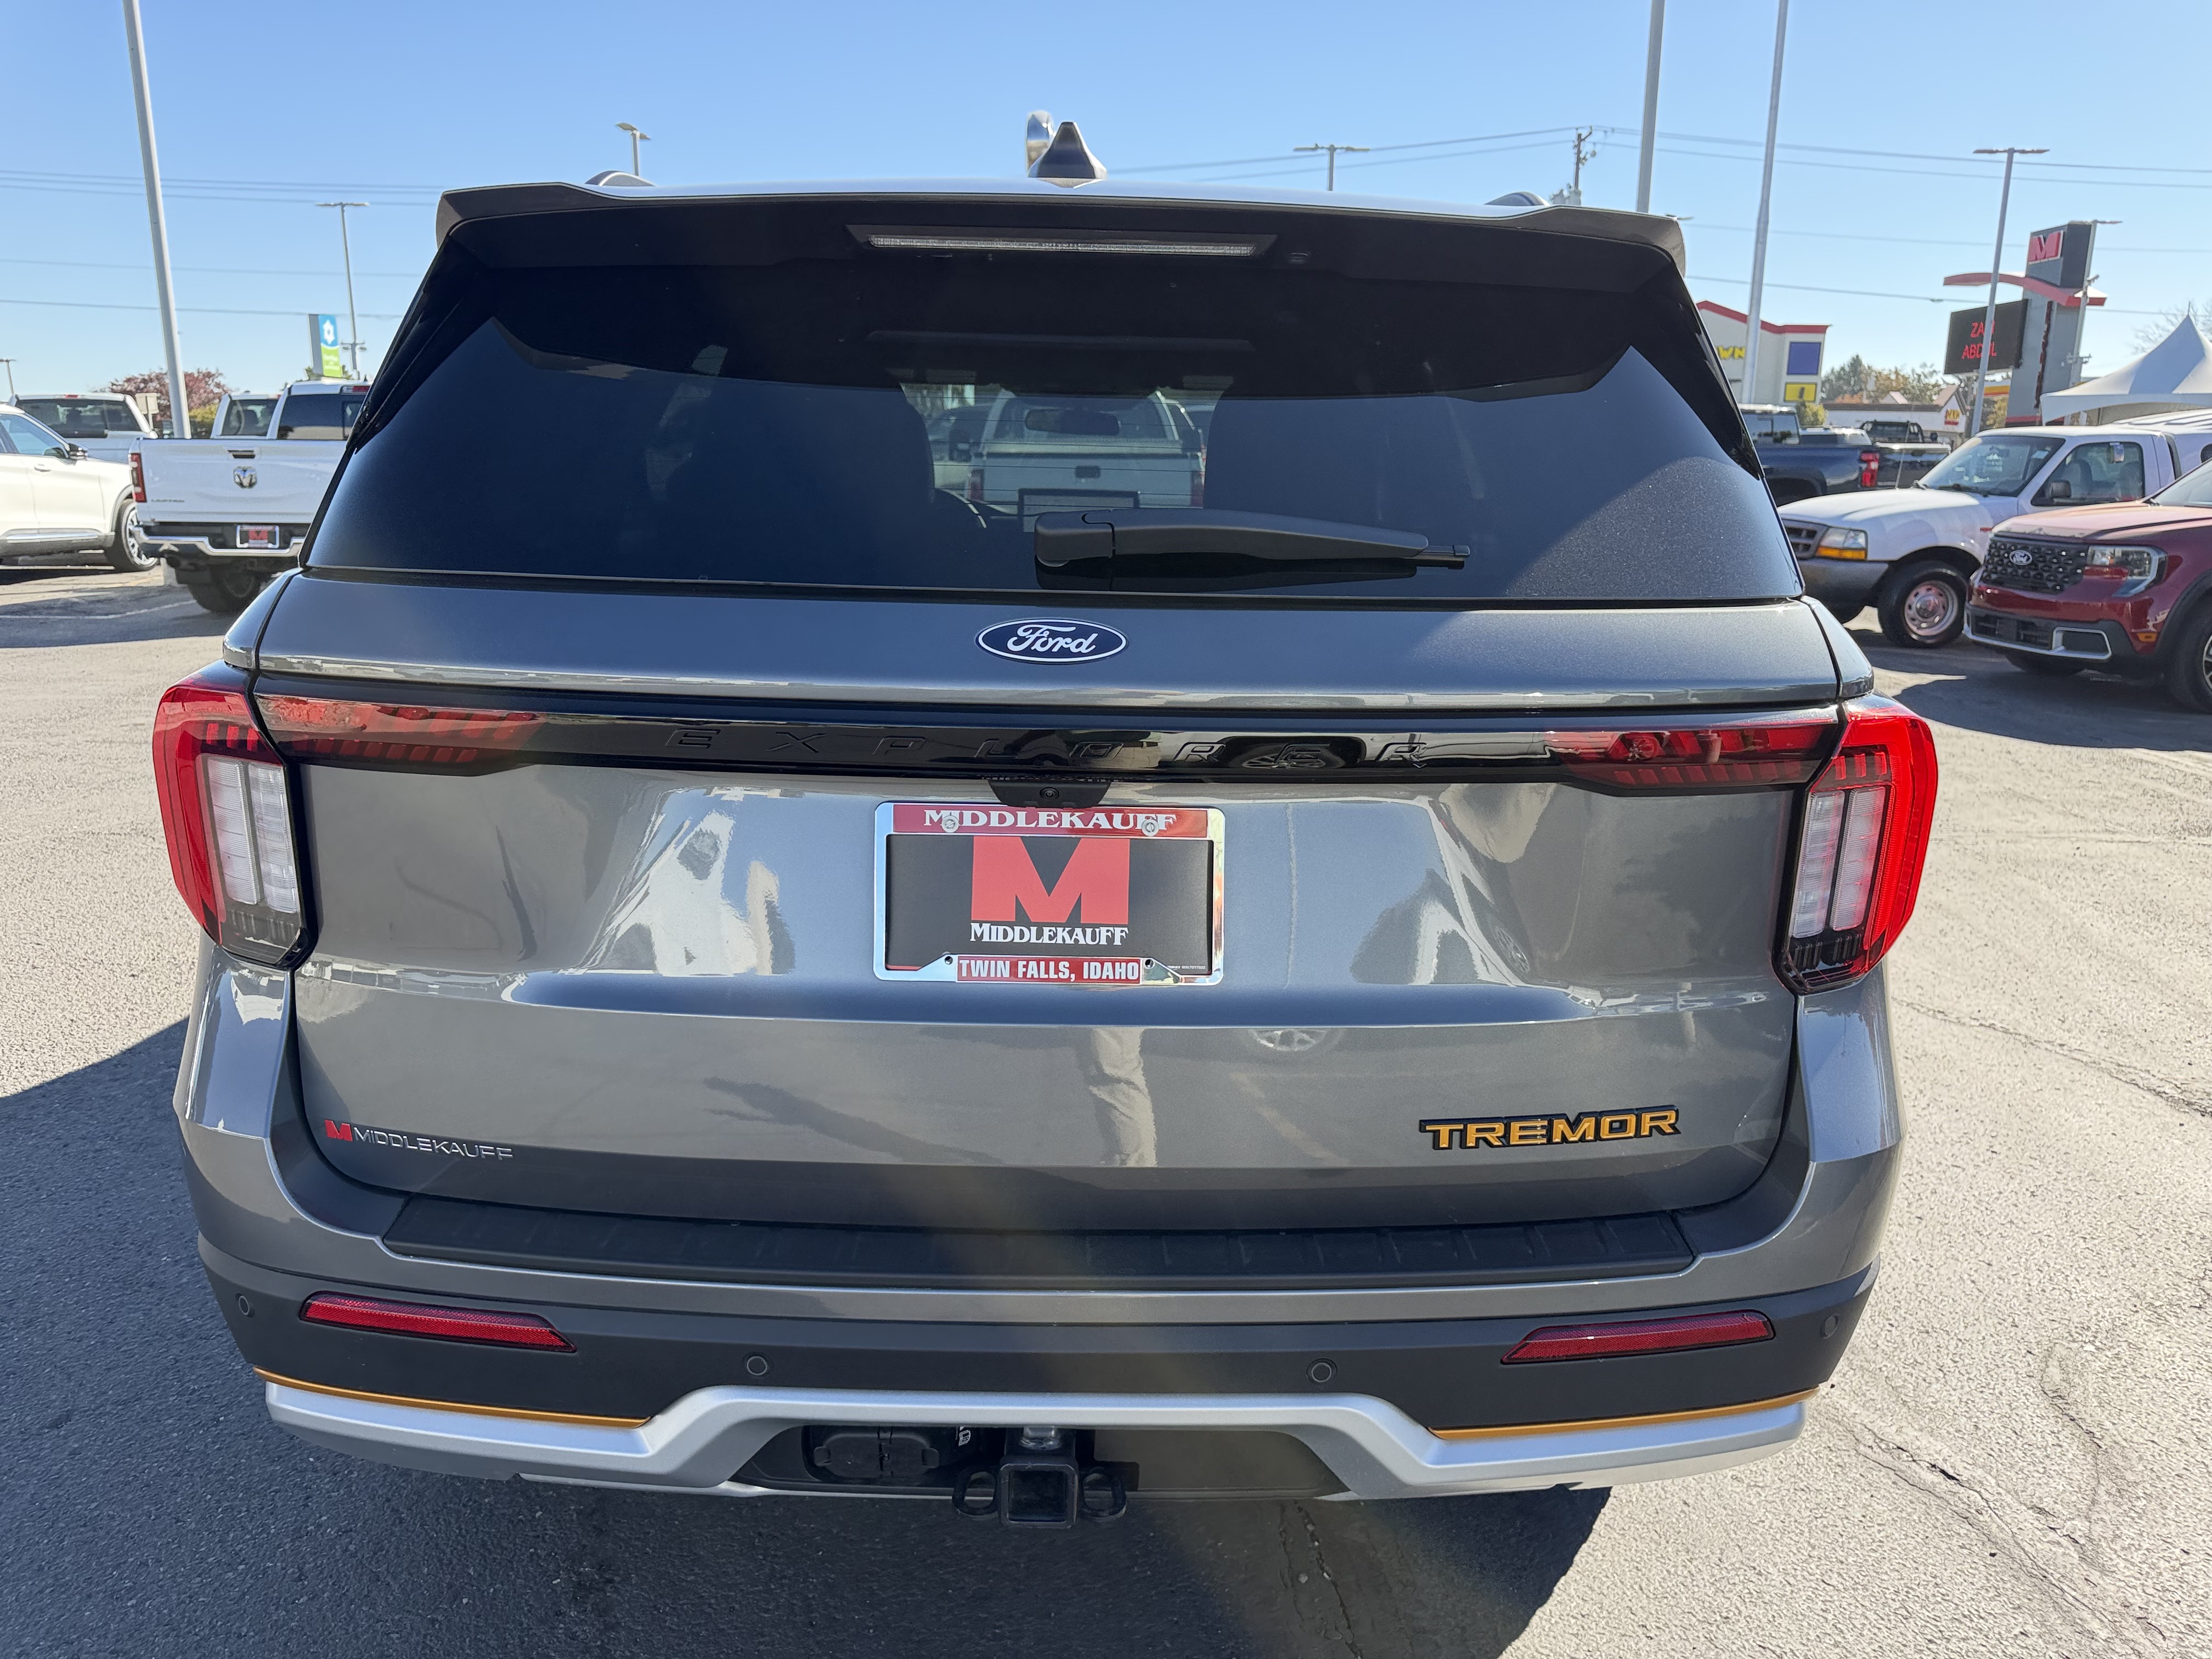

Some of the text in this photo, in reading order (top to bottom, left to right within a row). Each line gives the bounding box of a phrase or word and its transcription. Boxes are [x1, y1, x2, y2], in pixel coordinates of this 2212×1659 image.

[2028, 231, 2063, 263] M
[1971, 320, 1995, 337] ZA
[1007, 624, 1098, 653] Ford
[665, 727, 1429, 765] EXPLORER
[924, 809, 1177, 831] MIDDLEKAUFF
[970, 836, 1131, 925] M
[970, 922, 1129, 945] MIDDLEKAUFF
[960, 960, 1139, 982] TWIN FALLS, IDAHO
[324, 1119, 514, 1160] M MIDDLEKAUFF
[1420, 1105, 1680, 1149] TREMOR
